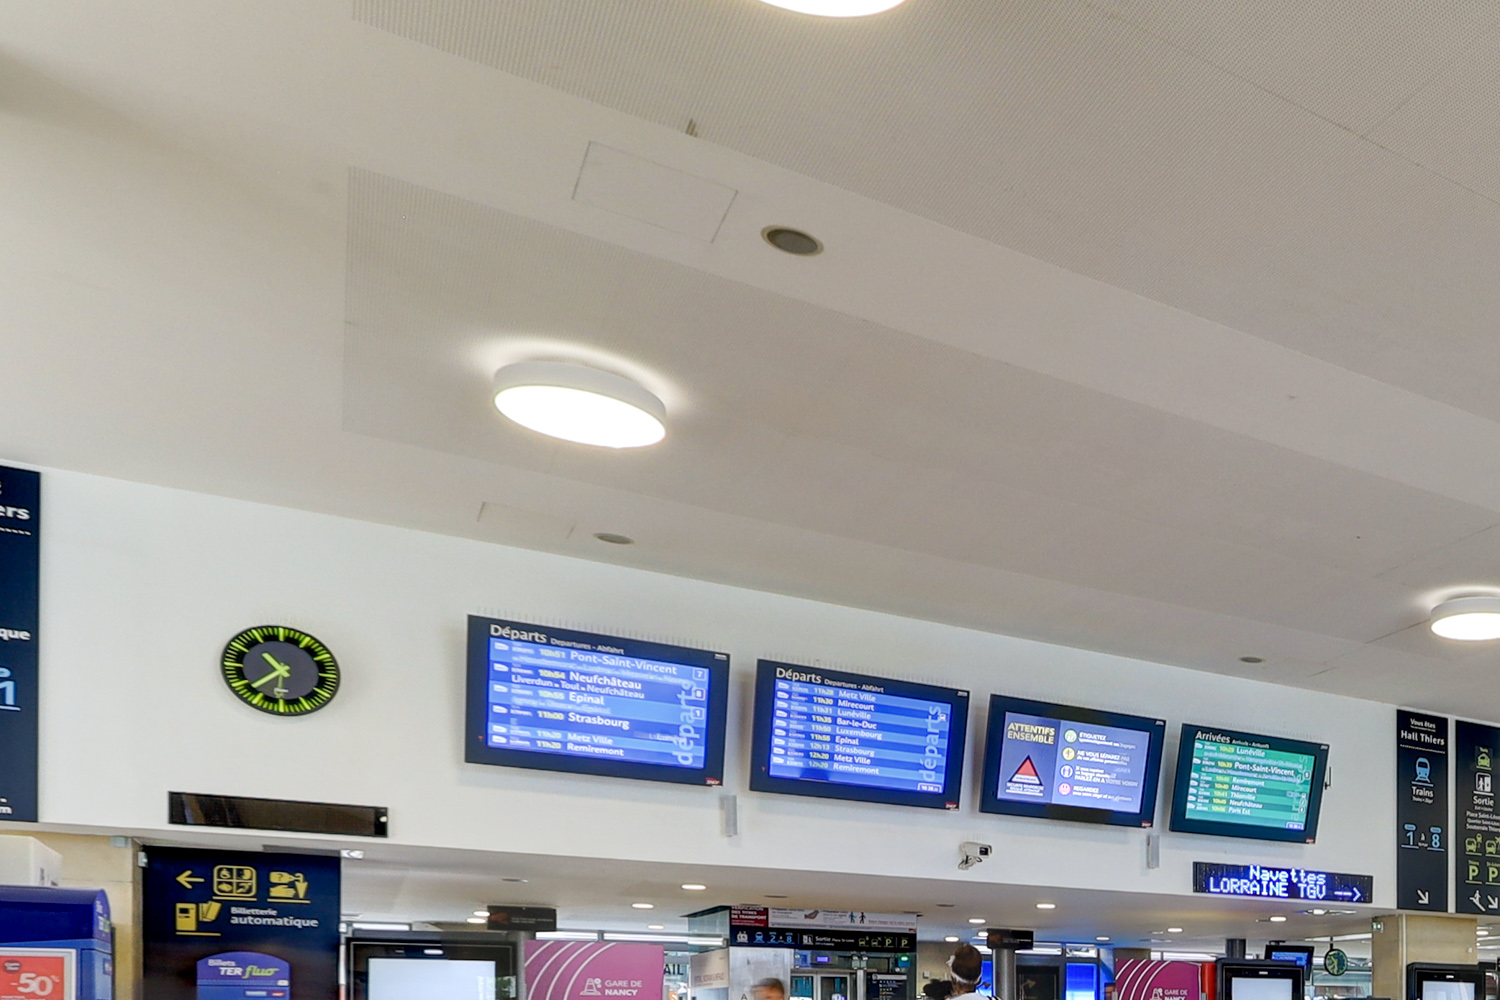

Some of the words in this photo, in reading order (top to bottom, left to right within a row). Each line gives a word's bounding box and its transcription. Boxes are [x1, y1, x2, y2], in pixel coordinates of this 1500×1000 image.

[491, 624, 547, 644] Départs
[550, 638, 592, 651] Departures
[571, 651, 678, 675] Pont-Saint-Vincent
[570, 671, 642, 690] Neufchâteau
[776, 667, 822, 684] Départs
[512, 674, 553, 688] Liverdun
[561, 680, 581, 692] Toul
[587, 684, 645, 700] Neufchâteau
[570, 691, 606, 706] Epinal
[839, 690, 859, 701] Metz
[860, 693, 877, 703] Ville
[838, 699, 875, 712] Mirecourt
[569, 711, 630, 731] Strasbourg
[838, 708, 872, 720] Lunéville
[837, 717, 877, 731] Bar-le-Duc
[1008, 722, 1055, 736] ATTENTIFS
[1410, 718, 1422, 727] Vous
[568, 732, 591, 743] Metz
[592, 735, 614, 746] Ville
[836, 726, 883, 741] Luxembourg
[1007, 731, 1054, 745] ENSEMBLE
[1195, 730, 1231, 744] Arrivées
[1401, 730, 1418, 741] Hall
[1420, 733, 1445, 746] Thiers
[567, 743, 625, 757] Remiremont
[918, 705, 942, 782] départs
[835, 744, 876, 758] Strasbourg
[1236, 746, 1266, 758] Lunéville
[834, 753, 853, 764] Metz
[854, 756, 871, 766] Ville
[833, 762, 880, 776] Remiremont
[1234, 761, 1295, 776] Pont-Saint-Vincent
[1231, 784, 1257, 794] Mirecourt
[1232, 777, 1265, 787] Remiremont
[1230, 792, 1256, 802] Thionville
[1412, 786, 1434, 798] Trains
[1229, 799, 1263, 810] Neufchâteau
[1473, 796, 1495, 807] Sortie
[1229, 807, 1242, 815] Paris
[1242, 808, 1251, 816] Est
[1407, 831, 1414, 845] 1
[1432, 833, 1440, 848] 8
[1249, 865, 1327, 885] Navettes
[1470, 866, 1479, 880] P
[1489, 868, 1498, 882] P
[1210, 877, 1289, 897] LORRAINE
[1298, 883, 1327, 899] TGV
[230, 907, 278, 916] Billetterie
[230, 916, 320, 929] automatique
[208, 959, 237, 967] Billets
[218, 967, 243, 976] TER
[242, 965, 280, 979] fluo
[605, 980, 627, 988] GARE
[630, 980, 643, 988] DE
